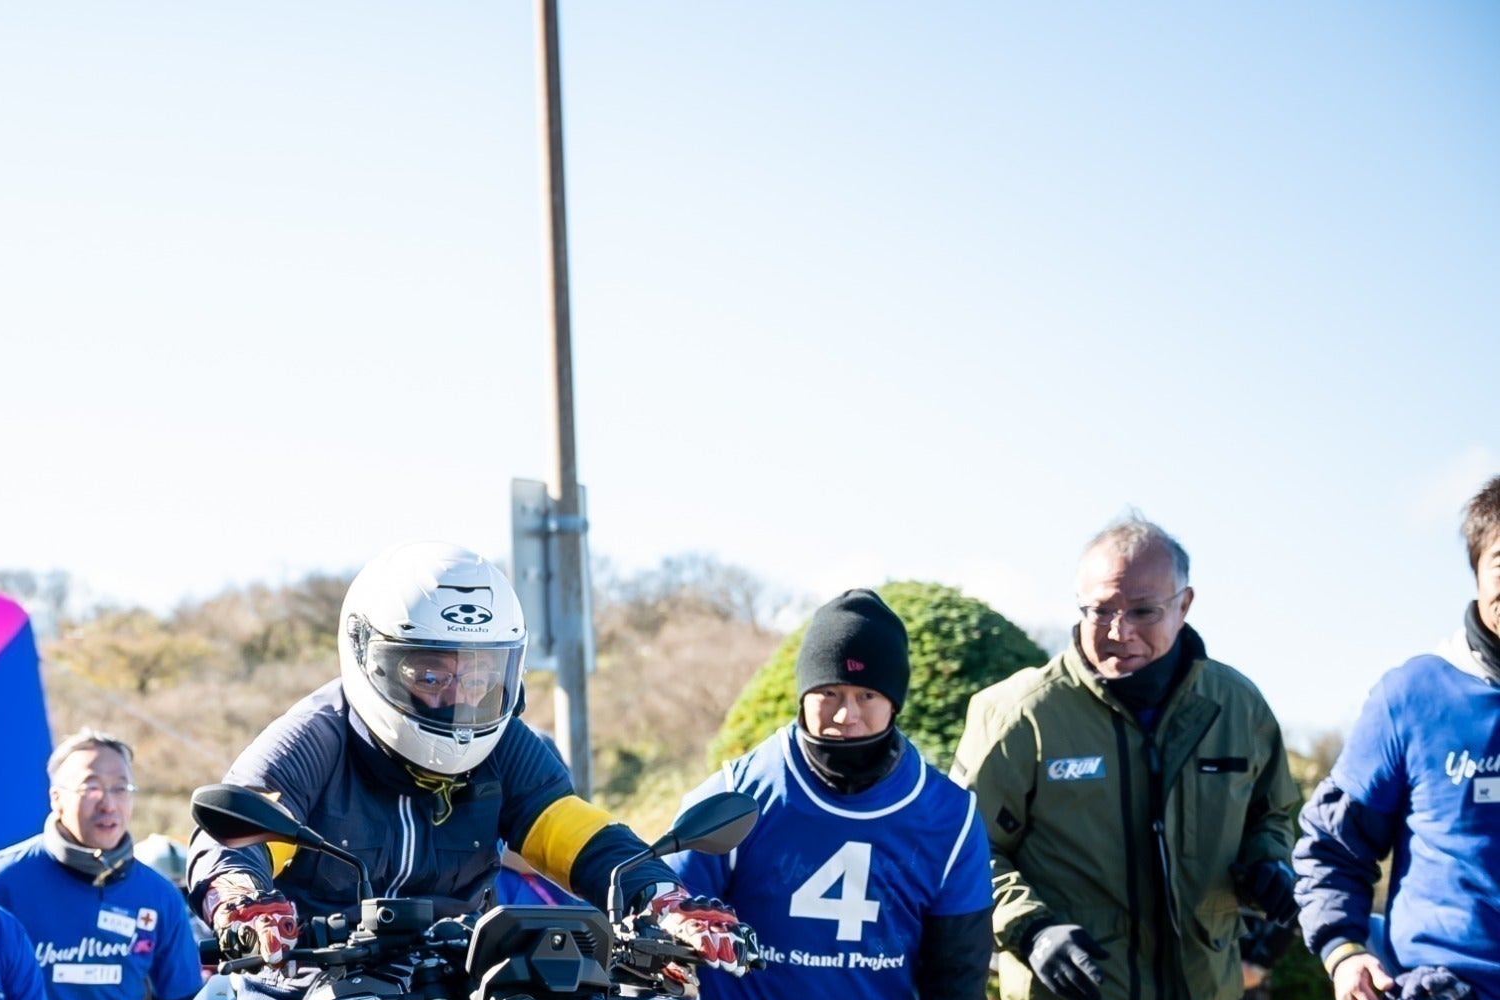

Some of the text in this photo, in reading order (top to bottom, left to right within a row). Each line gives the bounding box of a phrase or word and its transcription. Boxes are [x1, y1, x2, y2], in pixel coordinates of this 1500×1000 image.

[446, 625, 489, 633] Kabuto
[789, 841, 881, 942] 4
[758, 944, 905, 971] ide Stand Project
